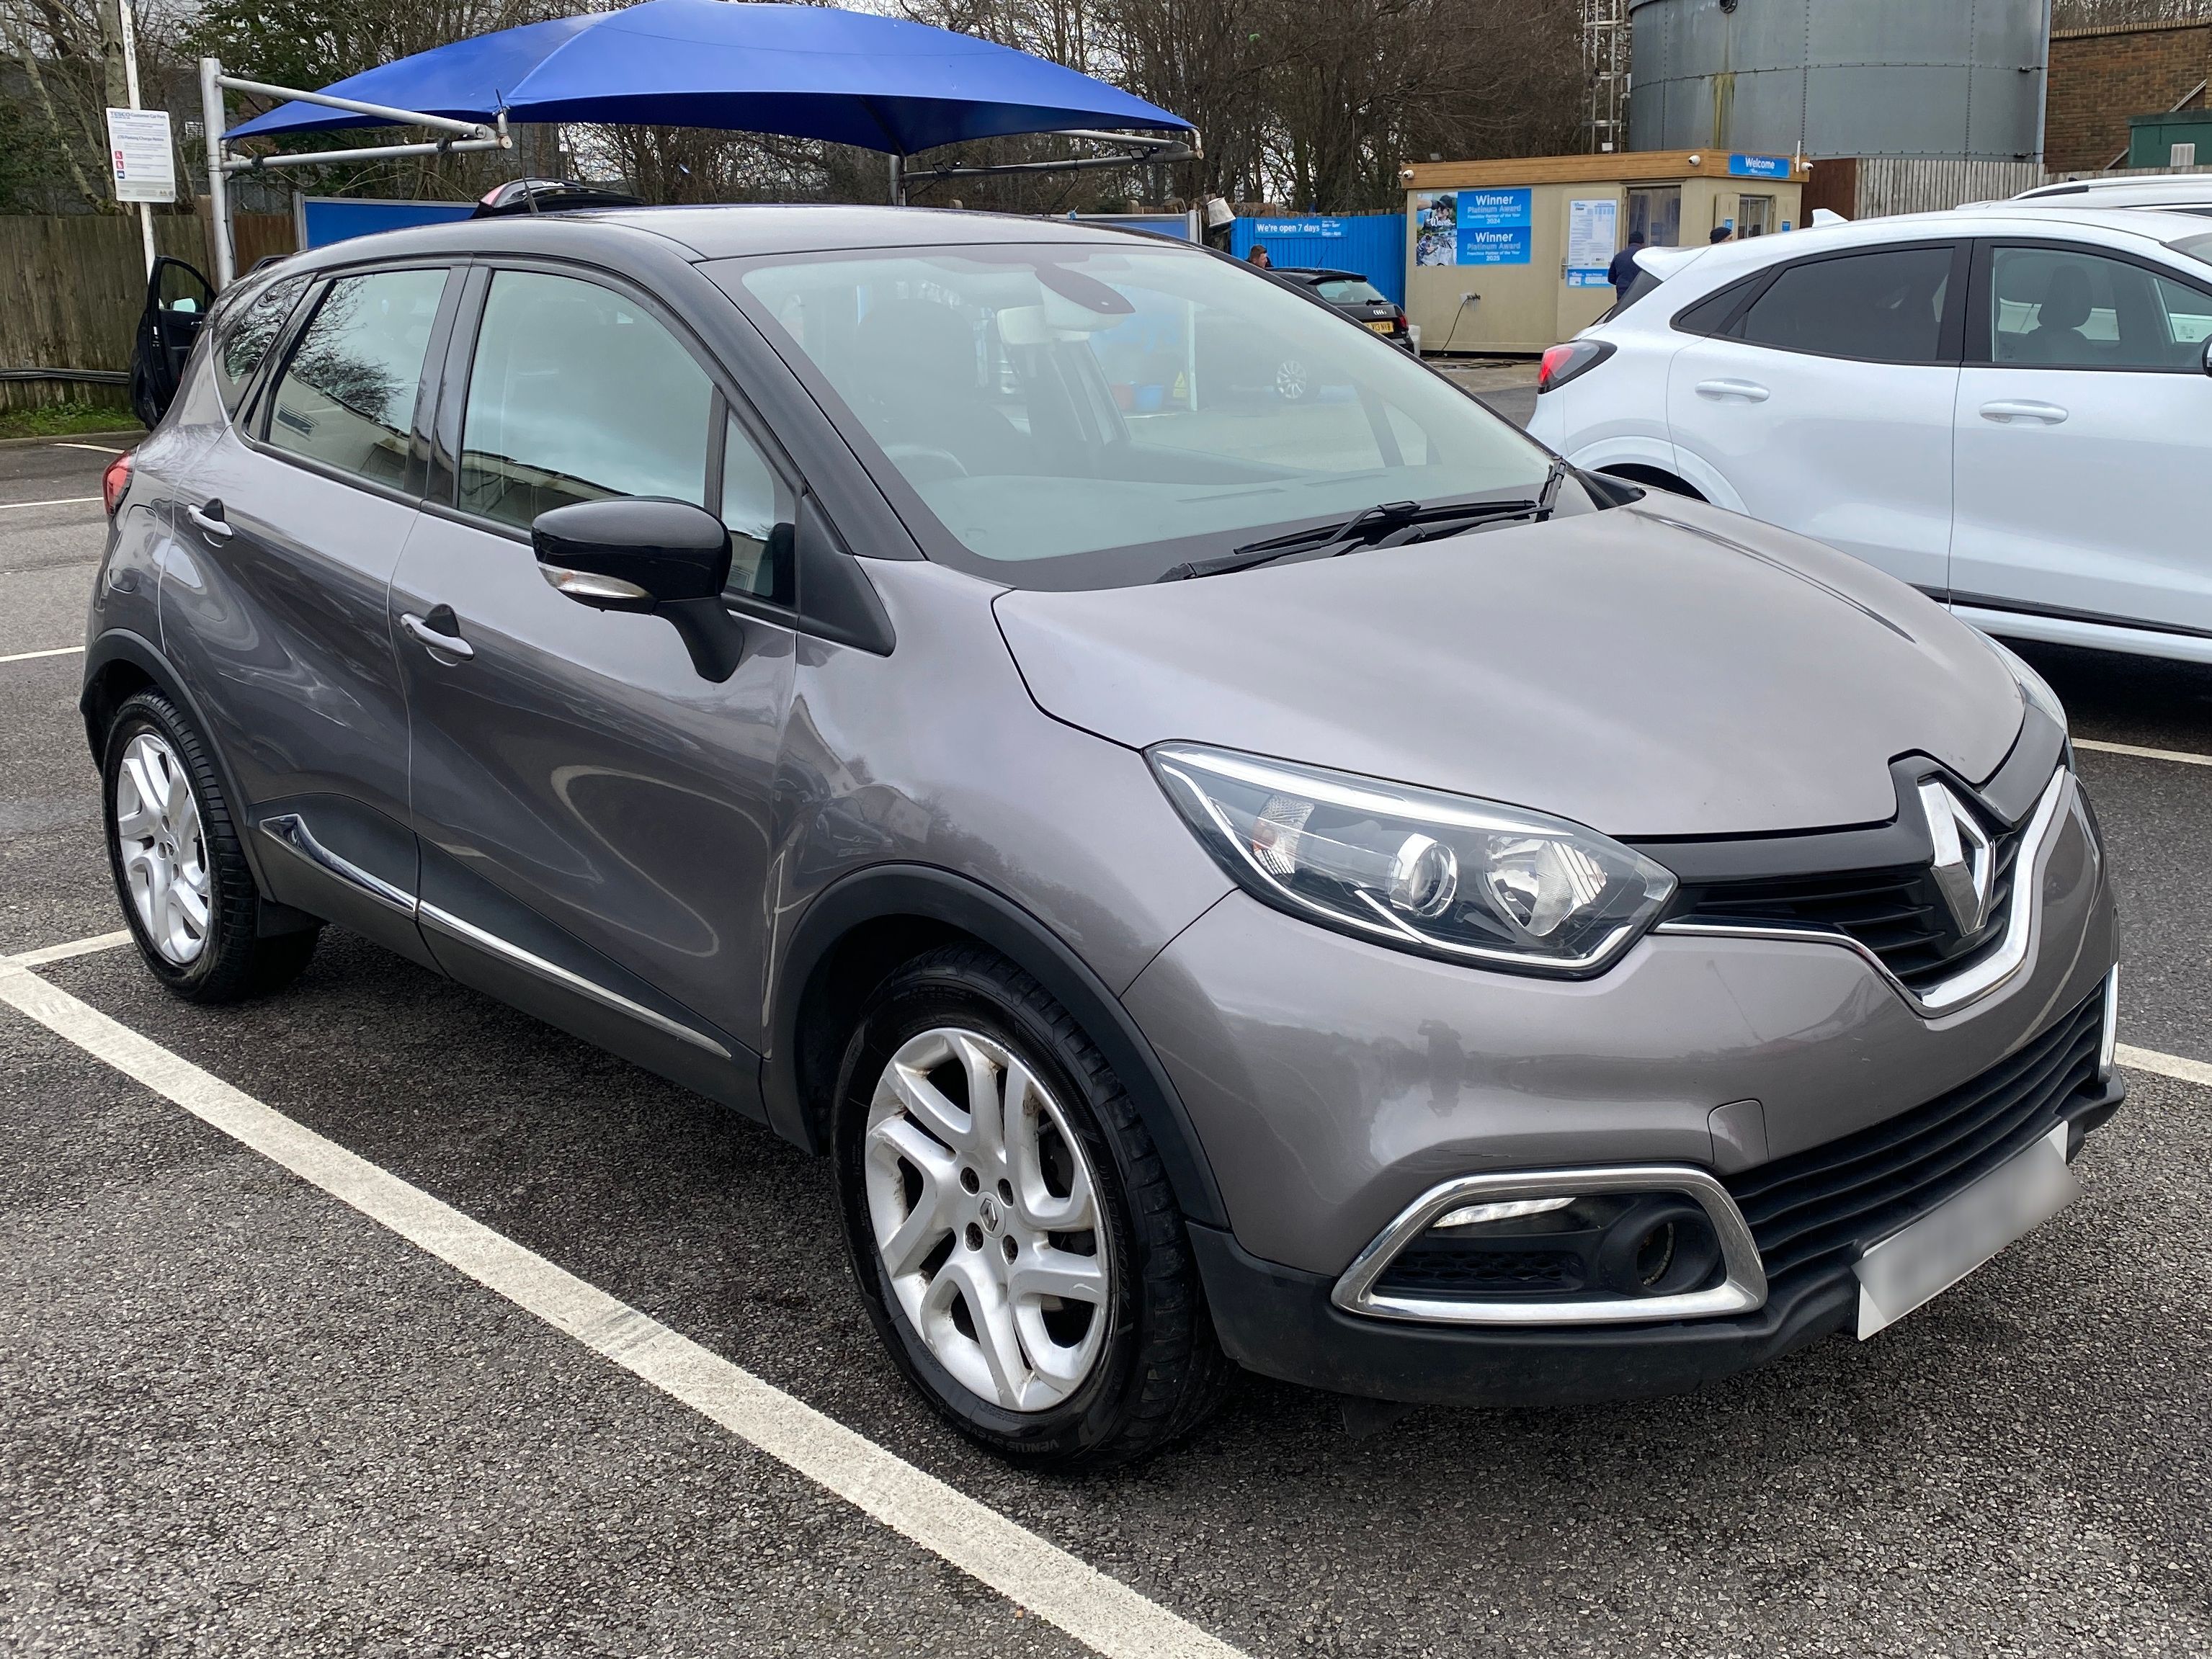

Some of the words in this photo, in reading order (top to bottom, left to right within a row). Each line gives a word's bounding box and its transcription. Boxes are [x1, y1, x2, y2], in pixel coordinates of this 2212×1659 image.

[1745, 157, 1775, 169] Welcome
[1476, 194, 1514, 206] Winner
[1499, 204, 1522, 213] Award
[1257, 223, 1277, 232] We're
[1280, 225, 1297, 233] open
[1298, 223, 1303, 232] 7
[1304, 223, 1320, 233] days
[1475, 231, 1513, 243] Winner
